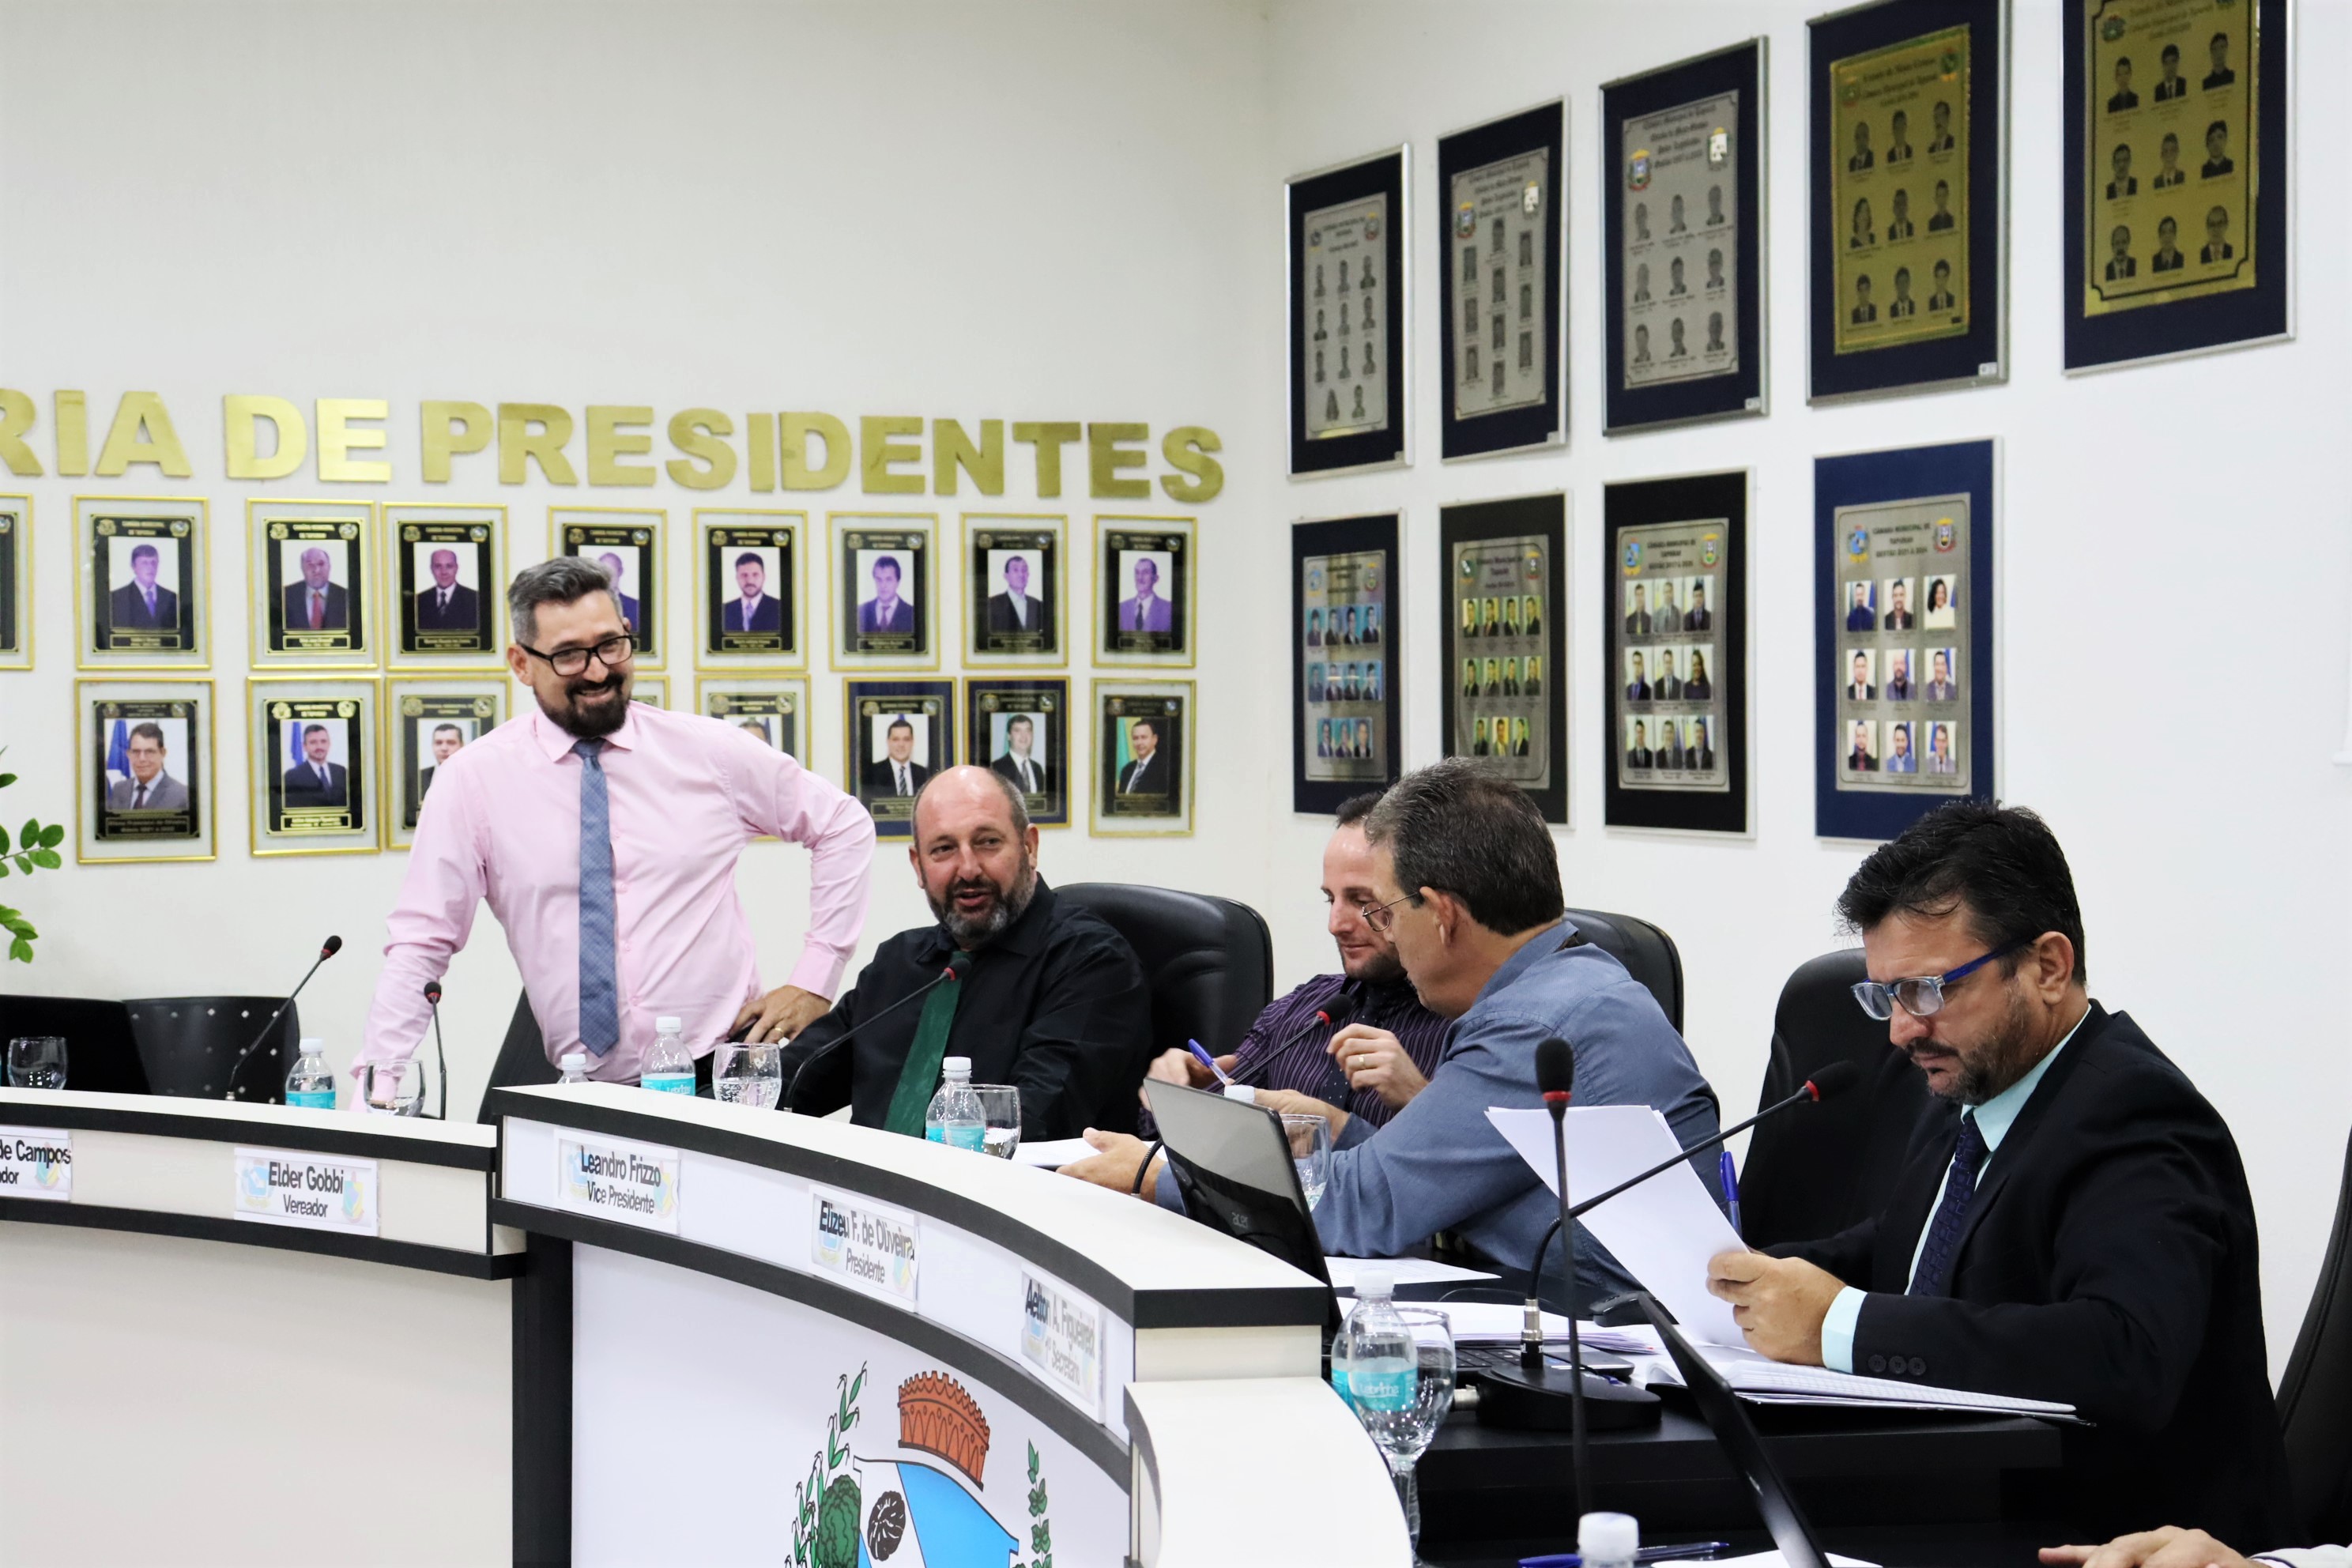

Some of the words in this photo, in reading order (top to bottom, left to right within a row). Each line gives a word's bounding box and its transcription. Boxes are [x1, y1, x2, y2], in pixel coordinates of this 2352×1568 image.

[223, 394, 391, 483] DE
[420, 400, 1224, 503] PRESIDENTES
[16, 1140, 72, 1169] Campos
[582, 1145, 627, 1181] Leandro
[630, 1154, 662, 1187] Frizzo
[0, 1166, 20, 1184] dor
[269, 1162, 303, 1189] Elder
[307, 1166, 344, 1194] Gobbi
[283, 1194, 328, 1217] Vereador
[587, 1181, 607, 1204] Vice
[608, 1185, 654, 1214] Presidente
[820, 1200, 850, 1238] Elizeu
[851, 1210, 860, 1242] F.
[861, 1215, 875, 1247] de
[876, 1219, 915, 1261] Oliveira
[846, 1247, 885, 1283] Presidente
